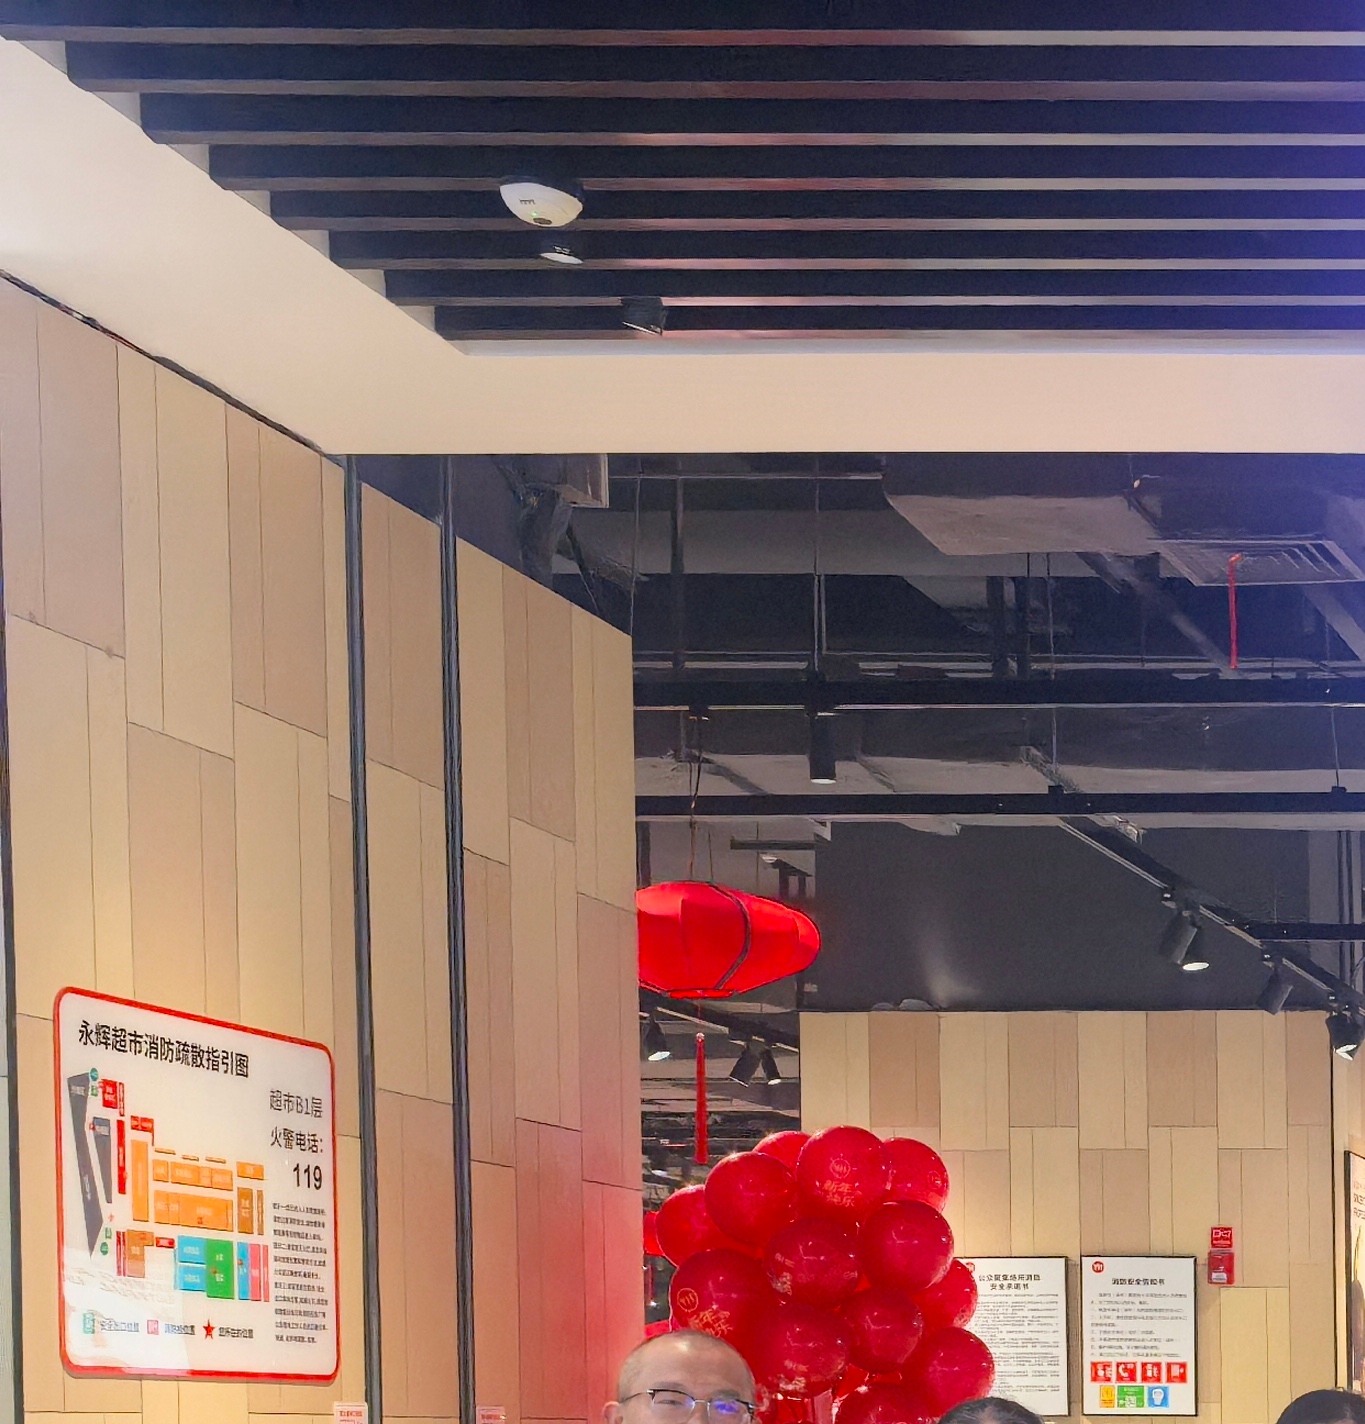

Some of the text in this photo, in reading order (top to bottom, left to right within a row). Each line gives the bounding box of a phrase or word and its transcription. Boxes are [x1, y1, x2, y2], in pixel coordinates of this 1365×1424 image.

[78, 1019, 249, 1078] 永辉超市消防疏散指引图
[269, 1088, 323, 1119] 超市B1层
[293, 1163, 323, 1190] 119
